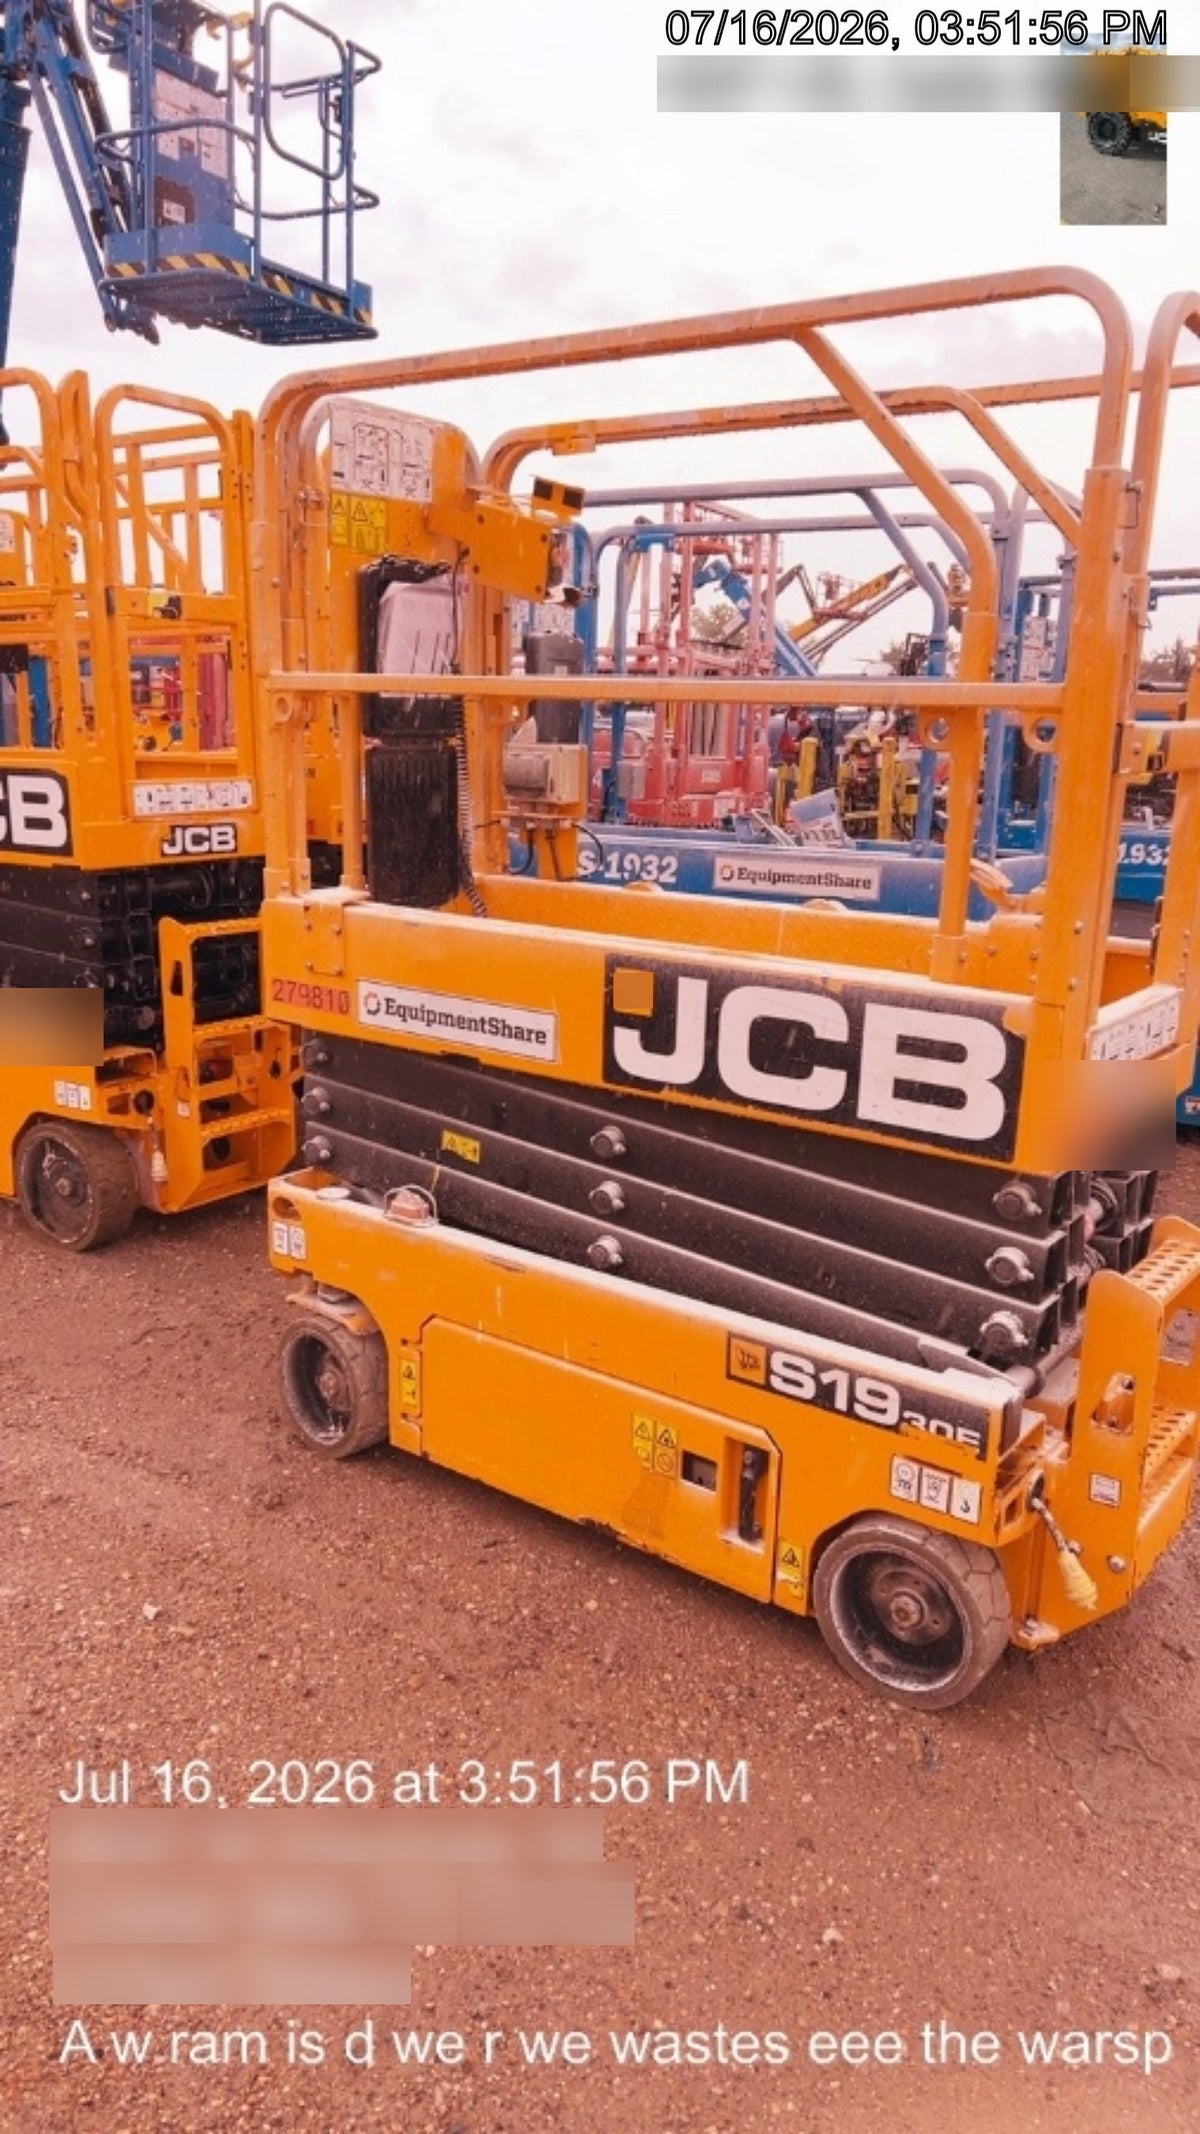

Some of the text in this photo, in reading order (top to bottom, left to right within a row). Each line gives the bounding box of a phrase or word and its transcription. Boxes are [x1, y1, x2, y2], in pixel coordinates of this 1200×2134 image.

[0, 774, 68, 848] B
[162, 826, 236, 855] JCB
[1117, 842, 1170, 866] 193
[736, 867, 872, 890] EquipmentShare
[272, 979, 350, 1014] 279810
[384, 997, 547, 1045] EquipmentShare
[613, 976, 1006, 1141] JCB
